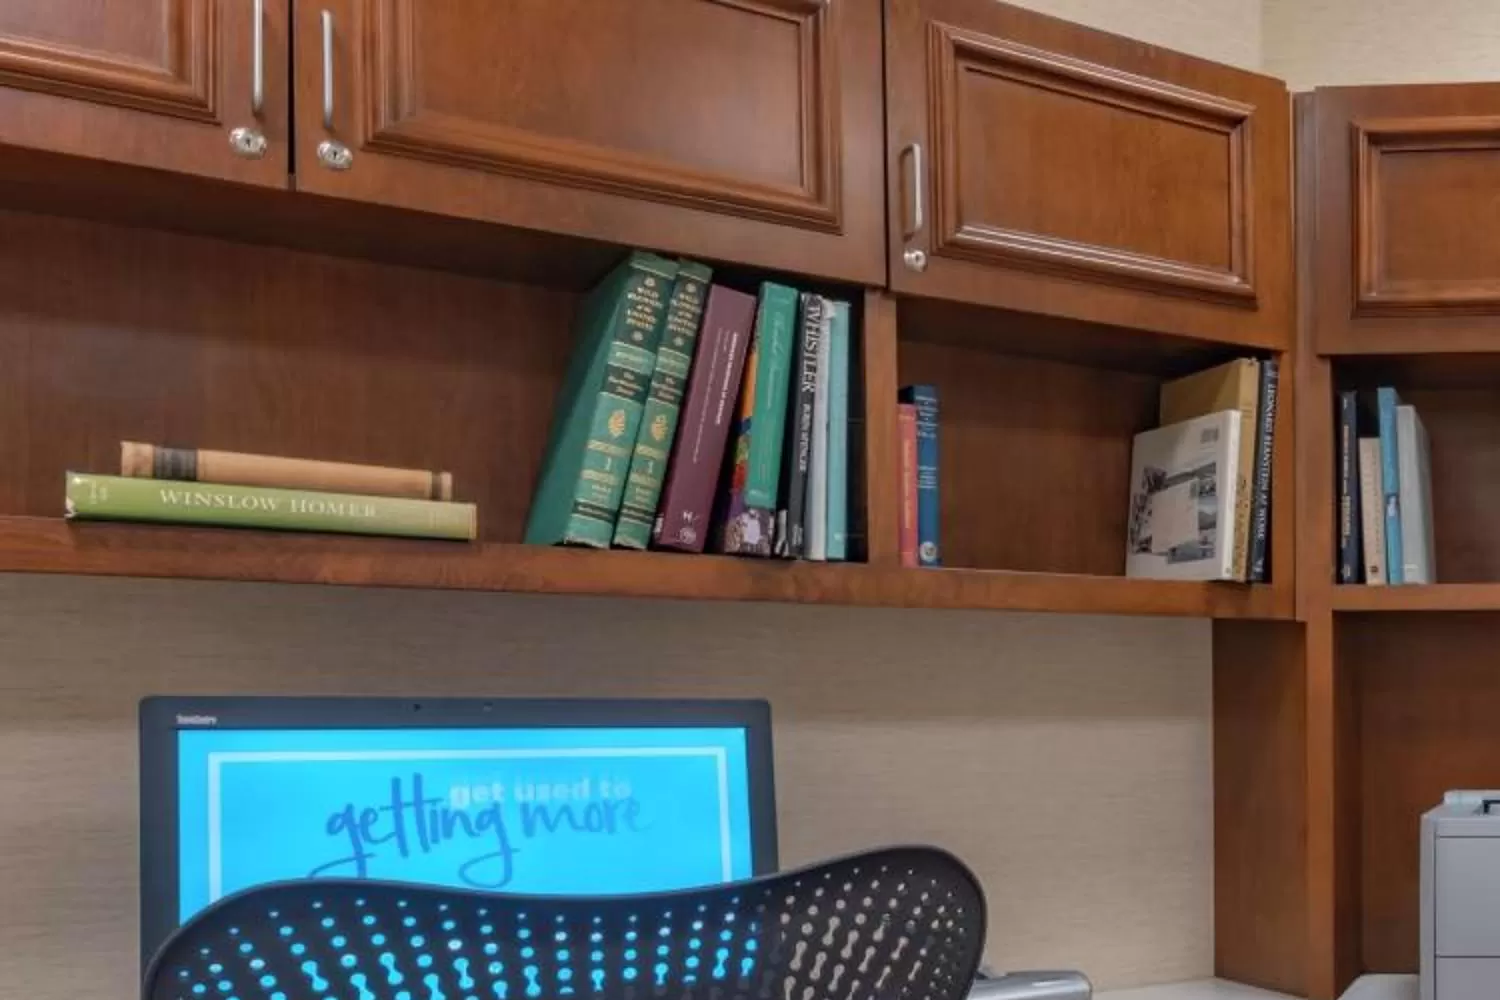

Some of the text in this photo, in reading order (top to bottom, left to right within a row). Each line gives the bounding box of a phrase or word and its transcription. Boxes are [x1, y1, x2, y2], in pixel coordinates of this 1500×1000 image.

[802, 306, 821, 393] WHISTLER
[159, 489, 376, 519] WINSLOW HOMER
[449, 778, 633, 810] get used to
[308, 772, 656, 888] getting more
